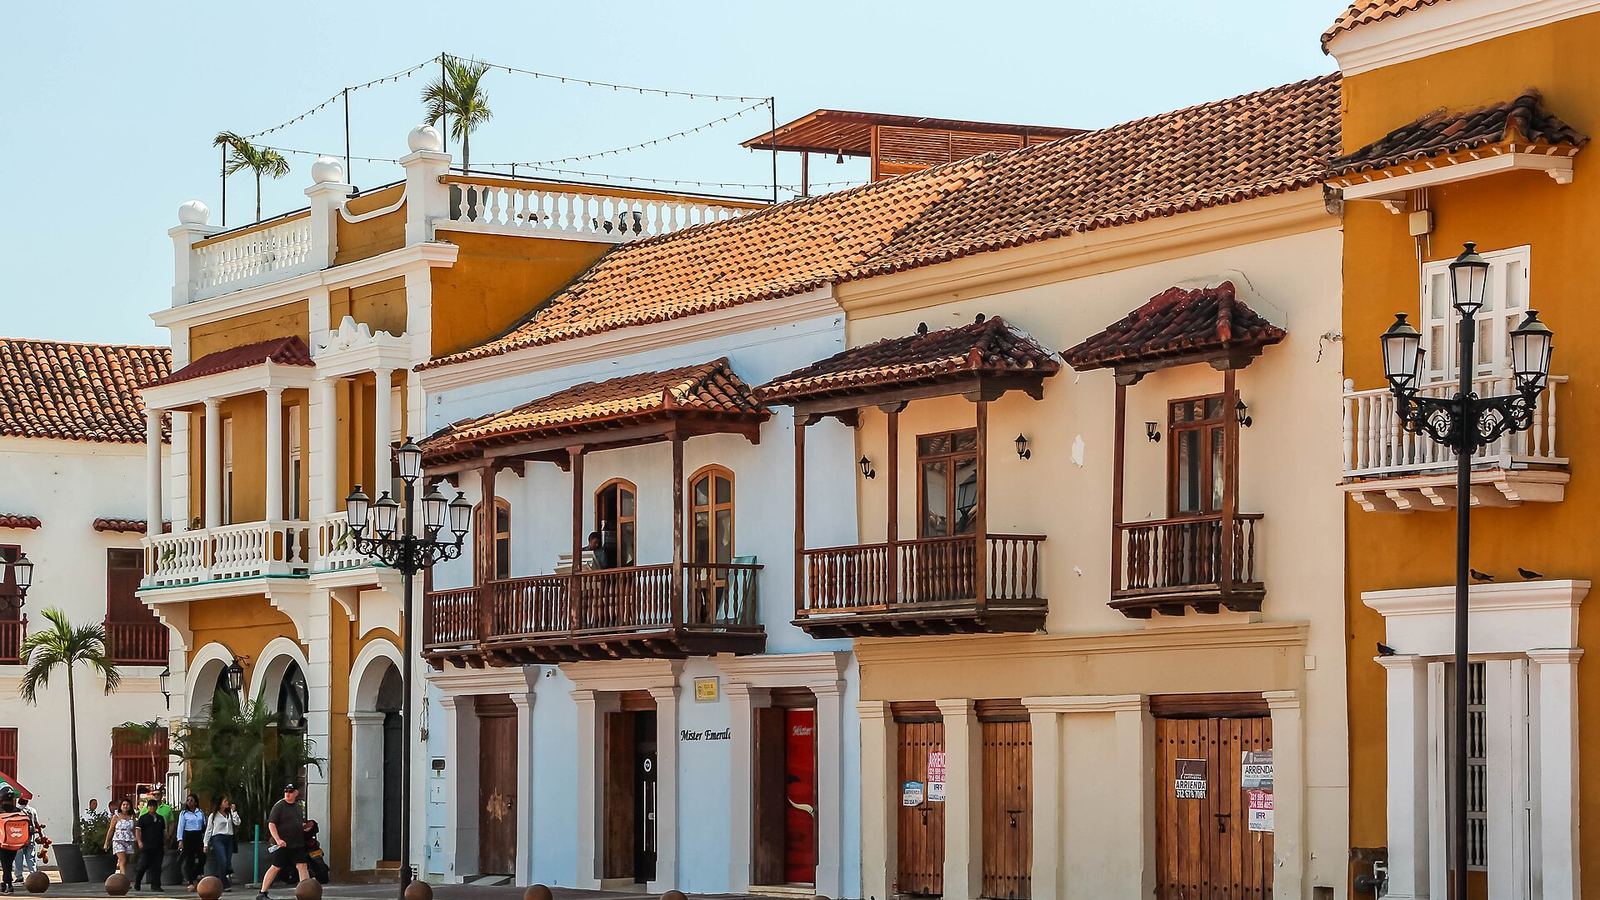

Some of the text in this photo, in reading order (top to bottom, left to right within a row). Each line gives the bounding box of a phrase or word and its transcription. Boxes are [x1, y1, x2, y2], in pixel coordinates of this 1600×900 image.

[680, 729, 702, 741] Mister
[1244, 765, 1273, 774] ARRIENDA
[1176, 780, 1206, 789] ARRIENDA
